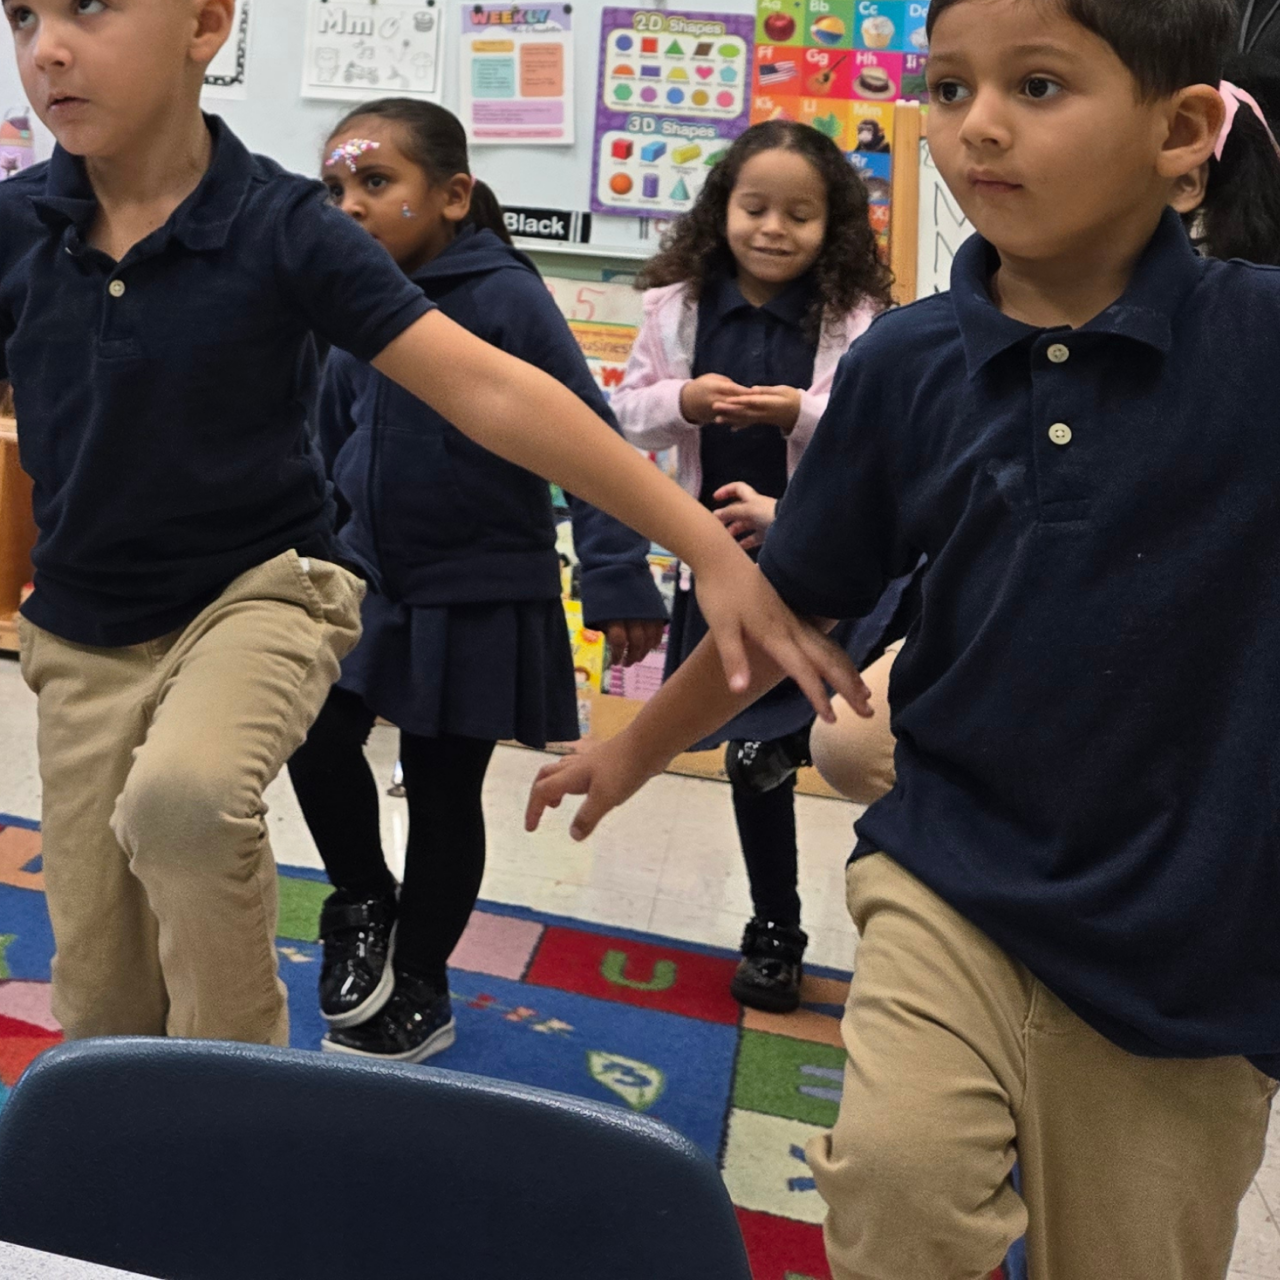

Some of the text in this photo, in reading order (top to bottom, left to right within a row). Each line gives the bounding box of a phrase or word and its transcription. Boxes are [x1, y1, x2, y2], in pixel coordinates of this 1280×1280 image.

[858, 1, 879, 15] Cc
[471, 9, 551, 26] WEEKLY
[635, 14, 722, 35] 2D Shapes
[757, 46, 774, 59] Ff
[805, 49, 830, 66] Gg
[855, 52, 878, 66] Hh
[852, 102, 883, 116] Mm
[628, 116, 717, 138] 3D Shapes
[850, 153, 869, 168] Rr
[503, 212, 565, 238] Black
